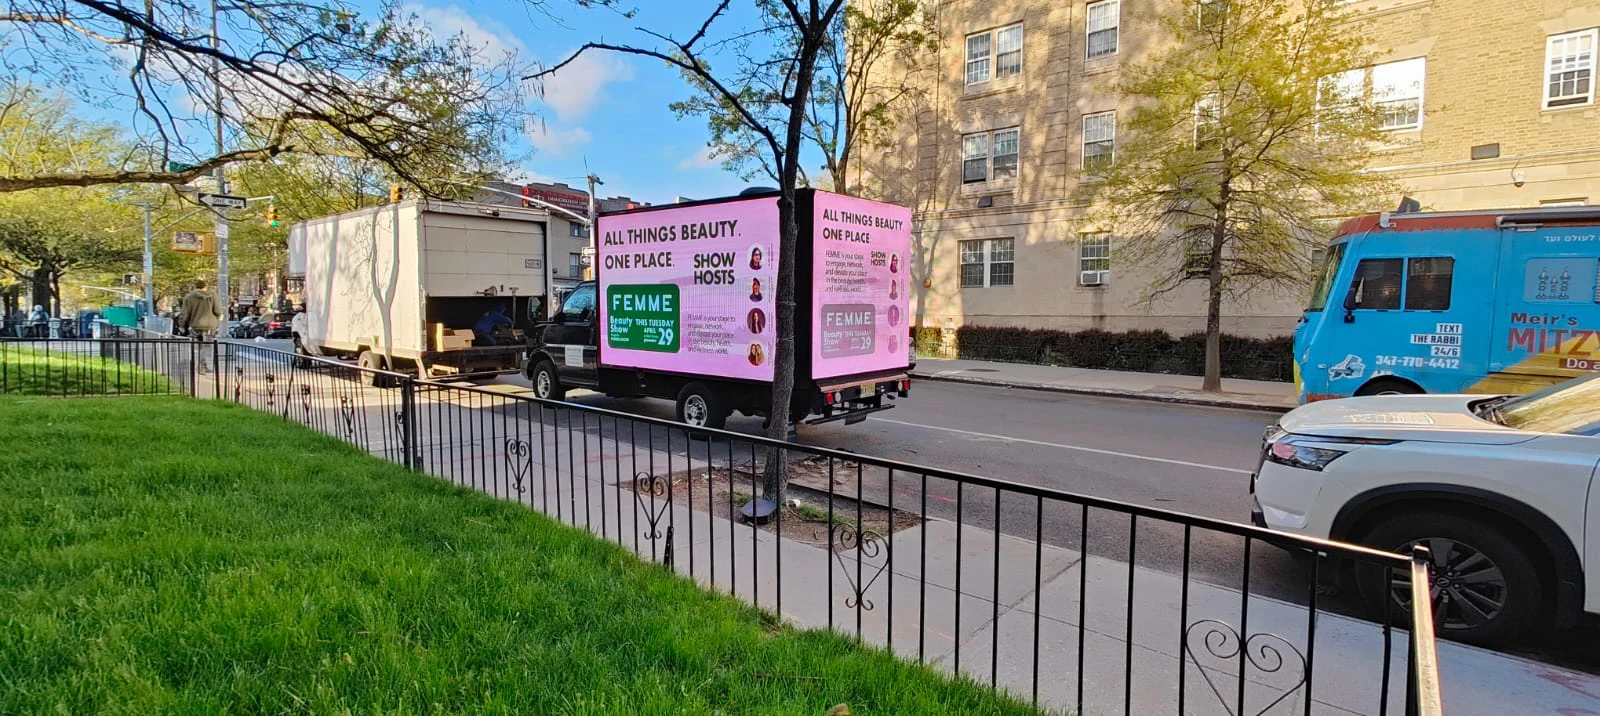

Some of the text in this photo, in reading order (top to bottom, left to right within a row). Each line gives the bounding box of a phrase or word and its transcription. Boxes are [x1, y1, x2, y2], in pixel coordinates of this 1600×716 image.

[823, 209, 838, 222] ALL
[841, 211, 873, 227] THINGS
[604, 220, 741, 246] ALL THINGS BEAUTY.
[823, 228, 842, 241] ONE
[1564, 234, 1596, 242] לעולם
[605, 251, 675, 269] ONE PLACE.
[694, 252, 736, 269] SHOW
[870, 250, 886, 259] SHOW
[870, 259, 886, 267] HOSTS
[694, 270, 735, 285] HOSTS
[612, 294, 673, 312] FEMME
[610, 315, 633, 328] Beauty
[635, 318, 674, 327] THIS TUESDAY
[826, 311, 871, 326] FEMME
[1511, 312, 1578, 326] Meir's
[610, 324, 628, 334] Show
[823, 330, 842, 339] Beauty
[1439, 324, 1460, 333] TEXT
[658, 327, 674, 346] 29
[861, 336, 871, 350] 29
[1413, 334, 1459, 344] THE RABBI
[1507, 327, 1600, 356] MITZ
[1434, 346, 1458, 356] 24/6
[1376, 355, 1460, 369] 347-770-4412
[1566, 358, 1588, 369] Do
